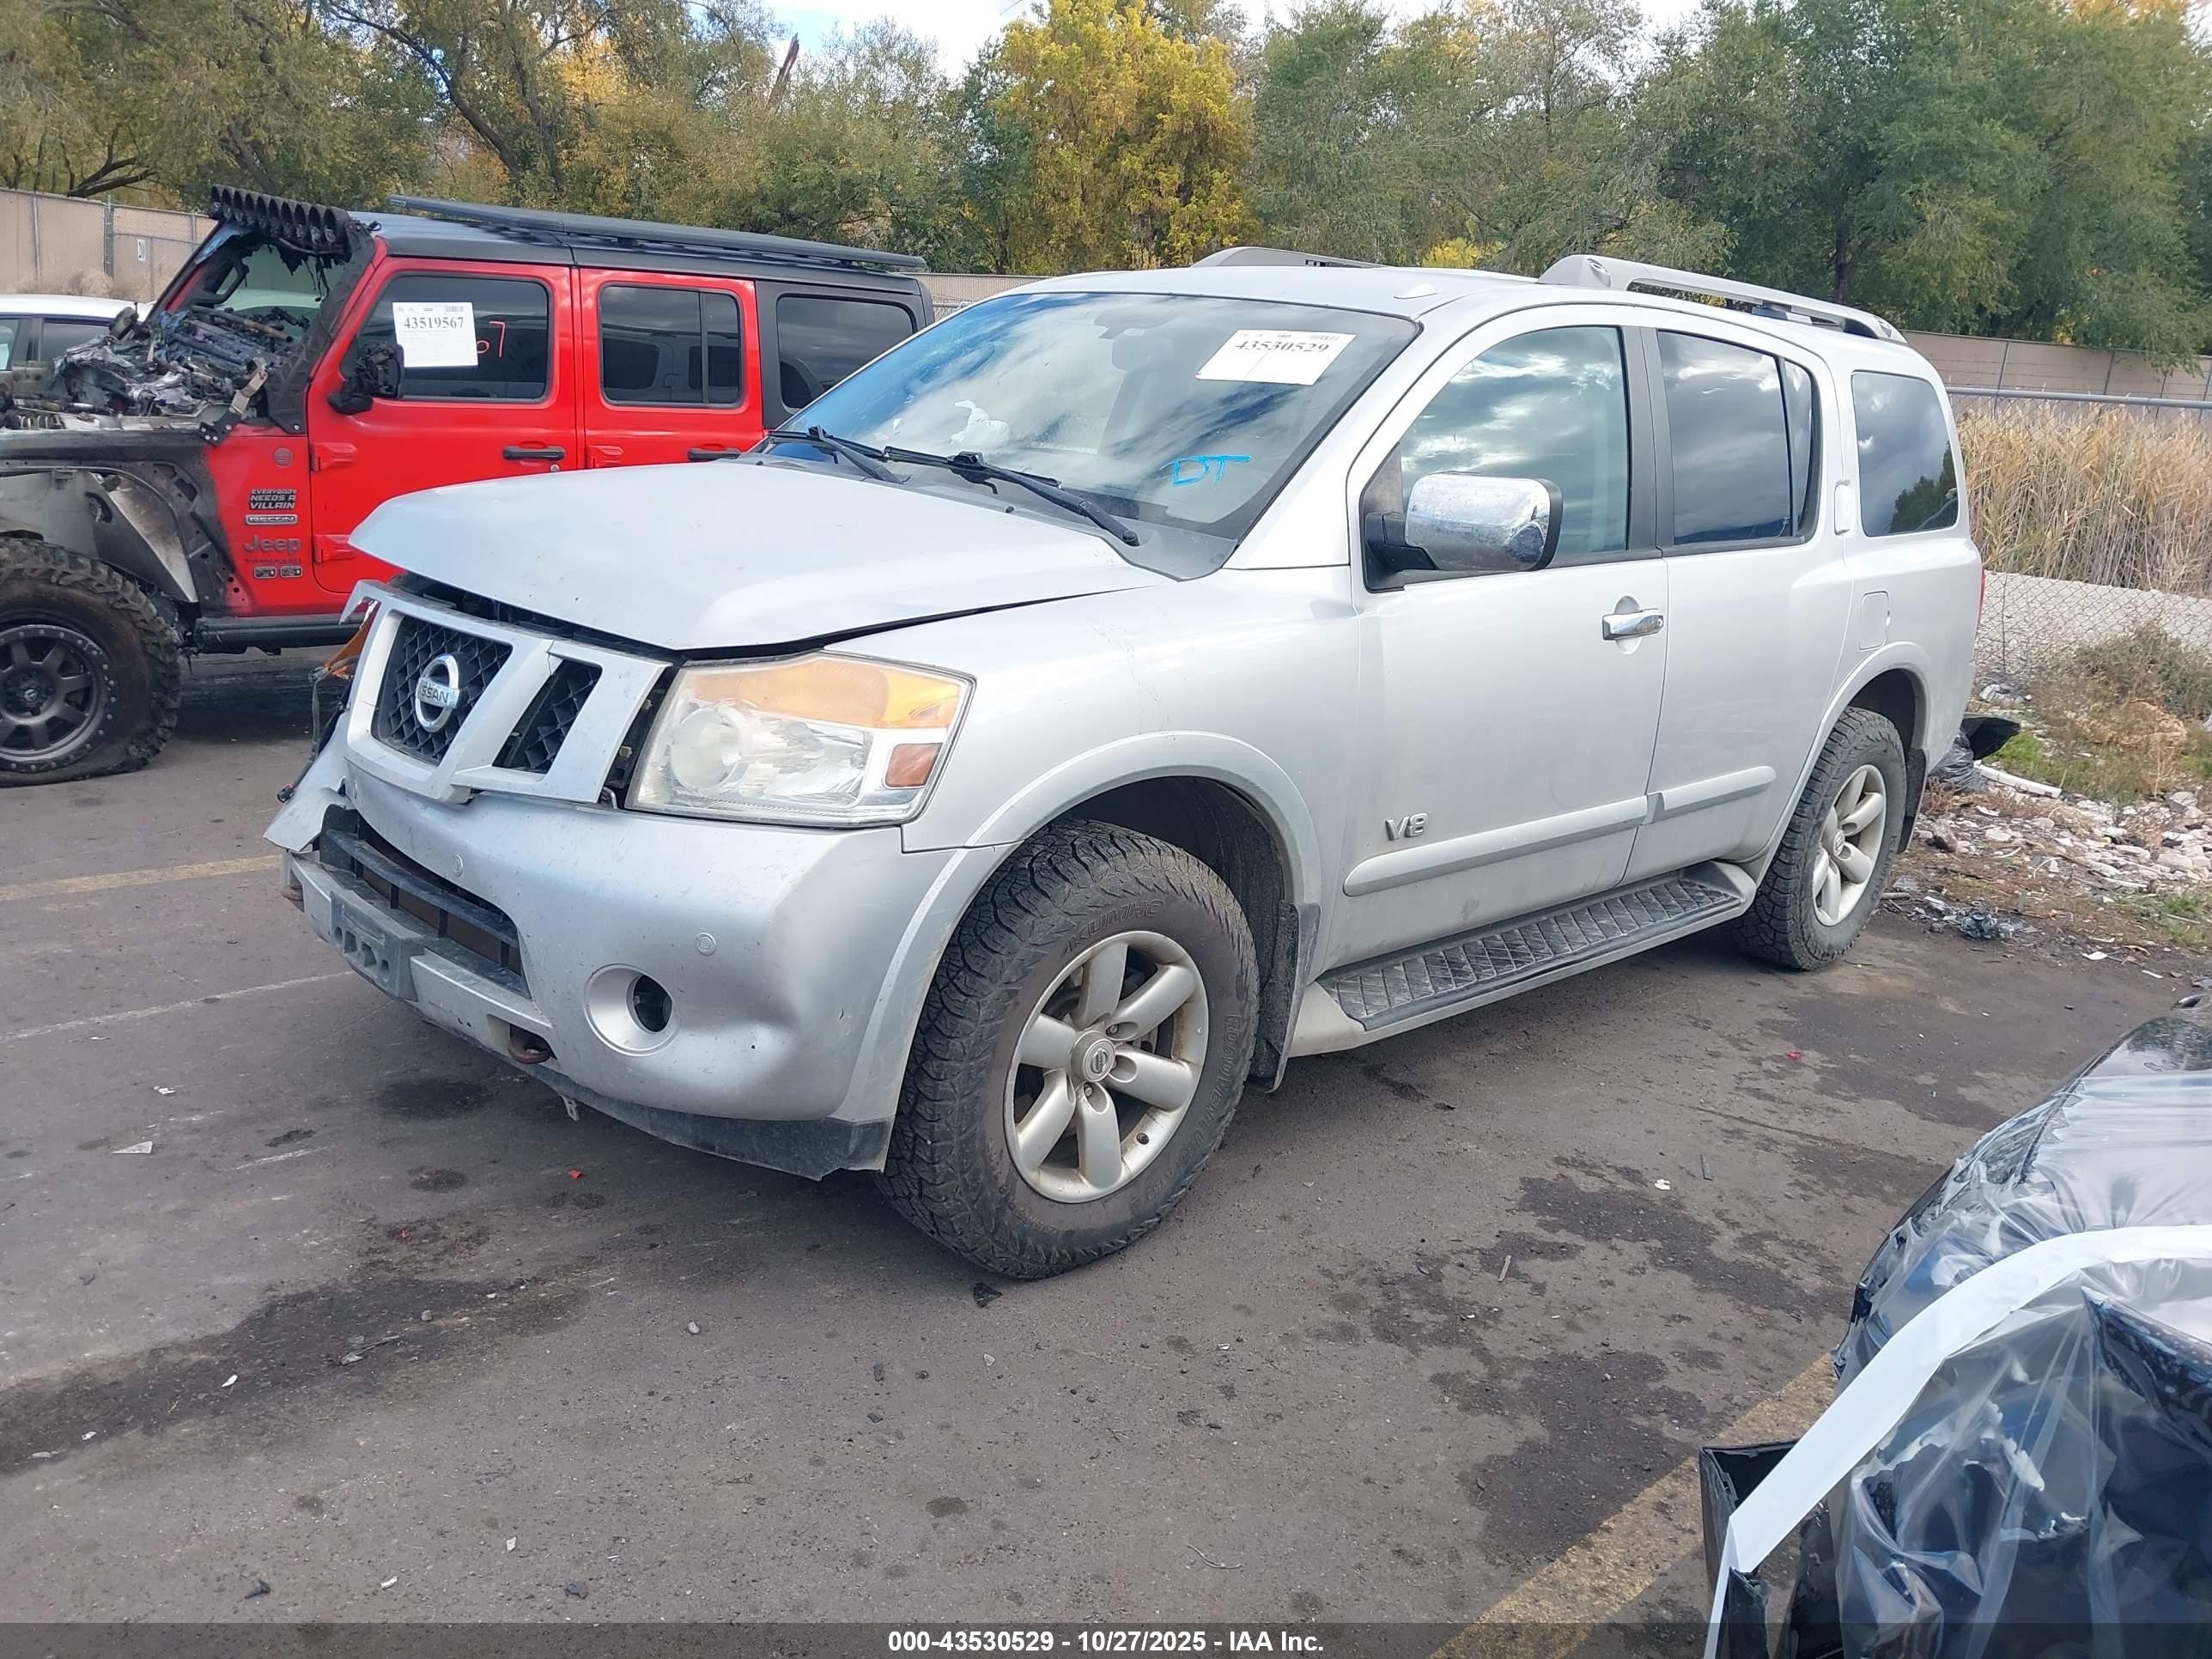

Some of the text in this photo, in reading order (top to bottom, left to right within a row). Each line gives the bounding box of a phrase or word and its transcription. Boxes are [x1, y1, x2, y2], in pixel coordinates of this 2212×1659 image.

[403, 316, 464, 329] 43519567
[1235, 340, 1329, 352] 43530529
[1160, 454, 1251, 489] DT
[244, 534, 301, 555] Jeep
[1385, 812, 1429, 841] V8
